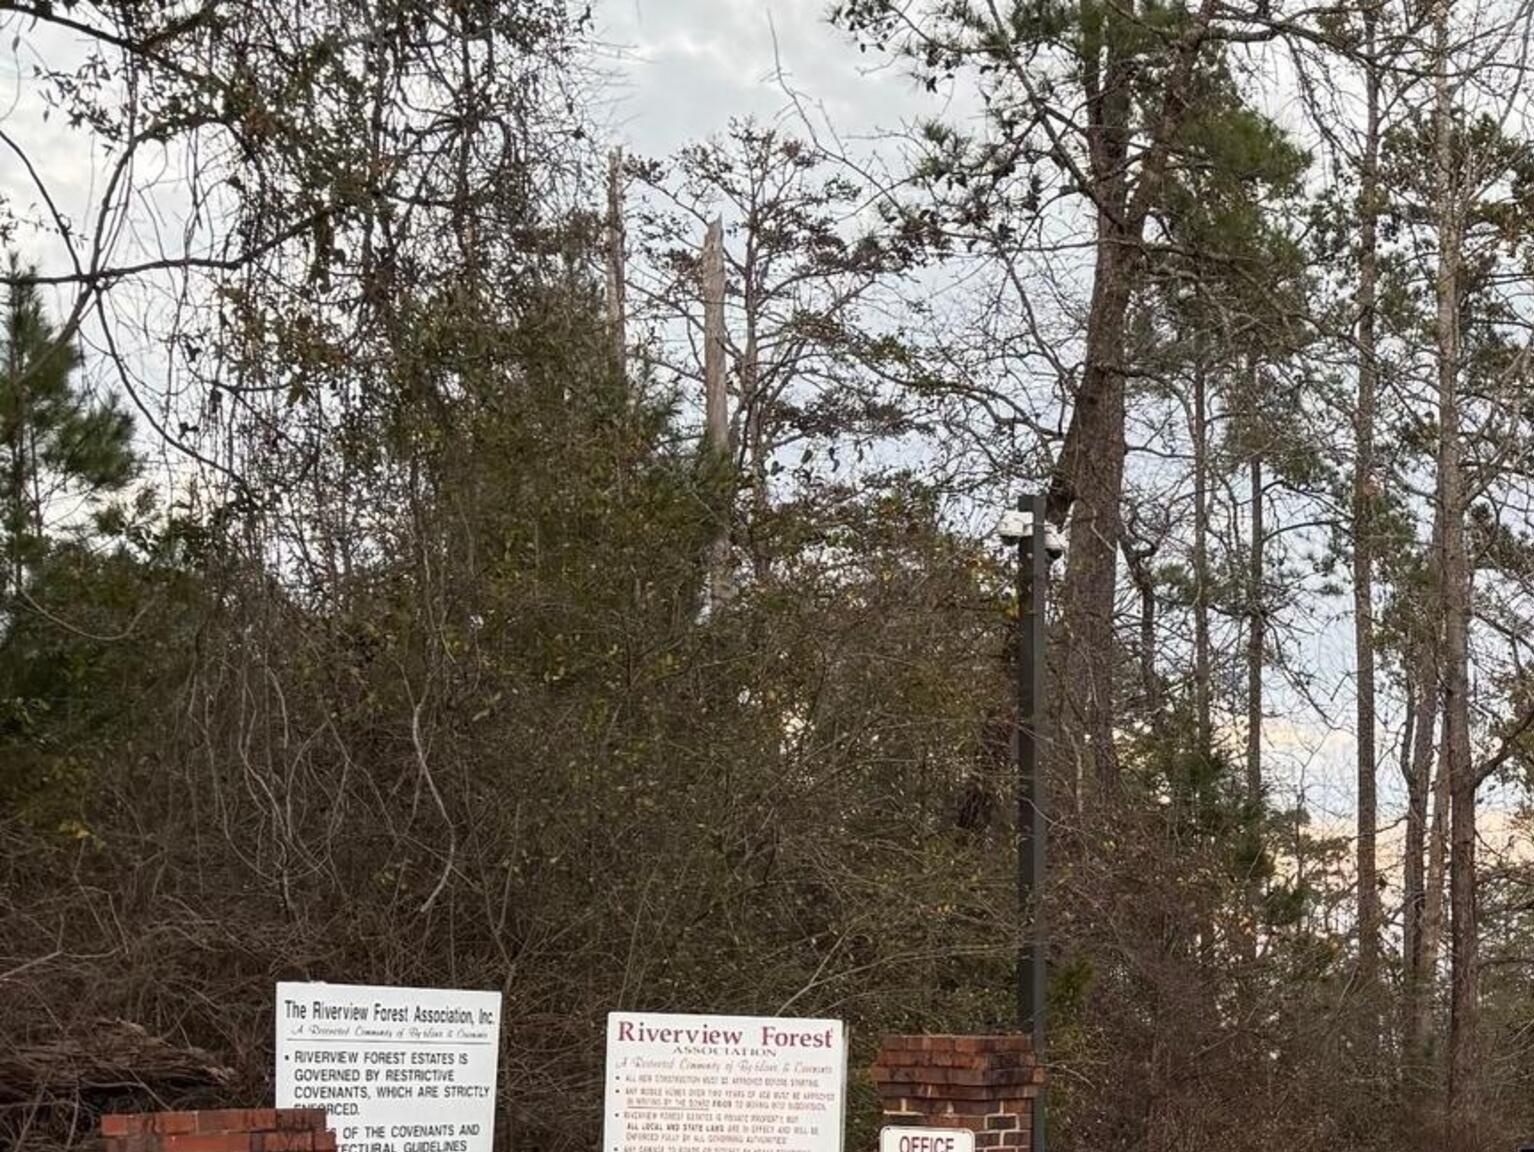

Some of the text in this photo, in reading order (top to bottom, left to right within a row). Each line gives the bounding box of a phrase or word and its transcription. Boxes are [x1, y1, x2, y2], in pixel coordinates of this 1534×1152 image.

[285, 1000, 495, 1026] The Riverview Forest Association, Inc.
[618, 1021, 833, 1048] Riverview Forest
[294, 1051, 469, 1065] RIVERVIEW FOREST ESTATES IS
[672, 1047, 777, 1057] ASSOCIATION
[294, 1069, 455, 1082] GOVERNED BY RESTRICTIVE
[294, 1086, 490, 1099] COVENANTS, WHICH ARE STRICTLY
[343, 1127, 359, 1139] OF
[365, 1126, 385, 1138] THE
[391, 1124, 454, 1138] COVENANTS
[459, 1124, 480, 1136] AND
